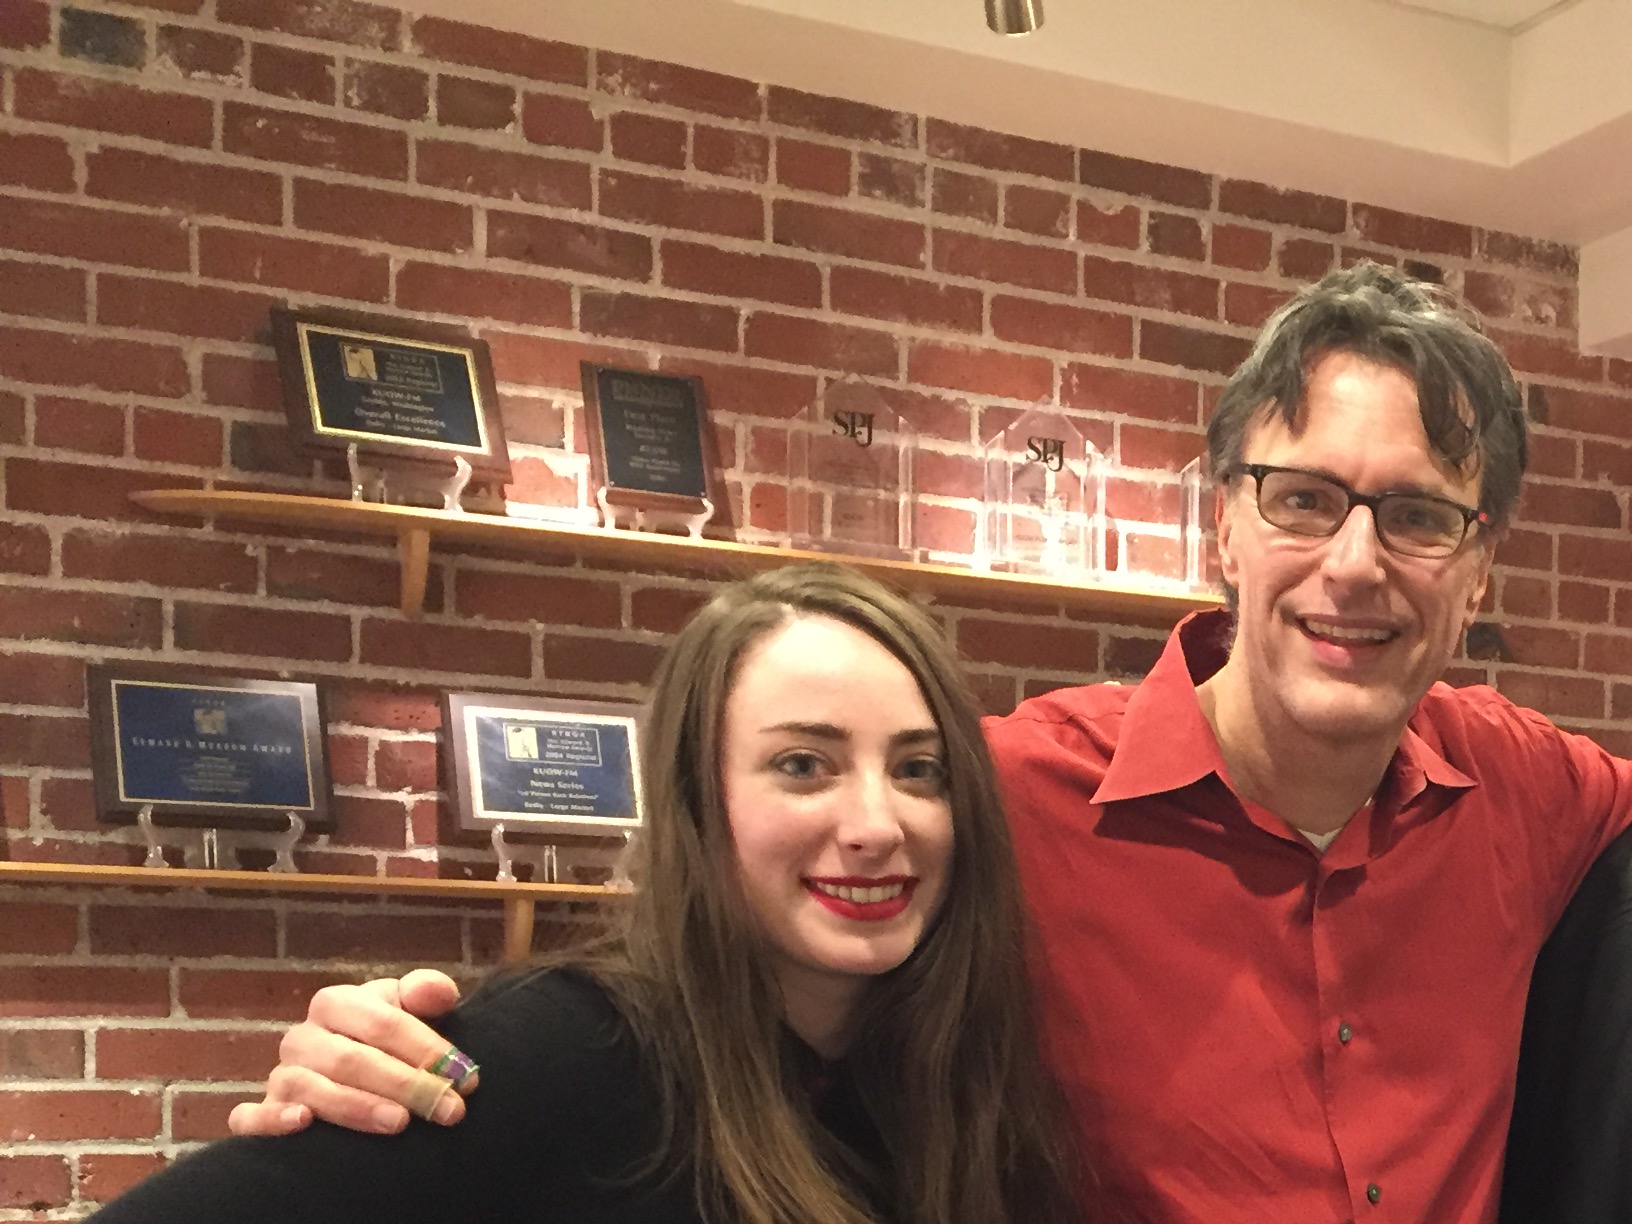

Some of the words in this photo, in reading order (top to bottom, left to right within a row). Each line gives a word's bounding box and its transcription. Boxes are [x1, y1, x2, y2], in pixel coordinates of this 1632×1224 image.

[832, 410, 875, 448] SPJ
[1026, 436, 1067, 473] SPJ
[252, 743, 292, 754] AWARD
